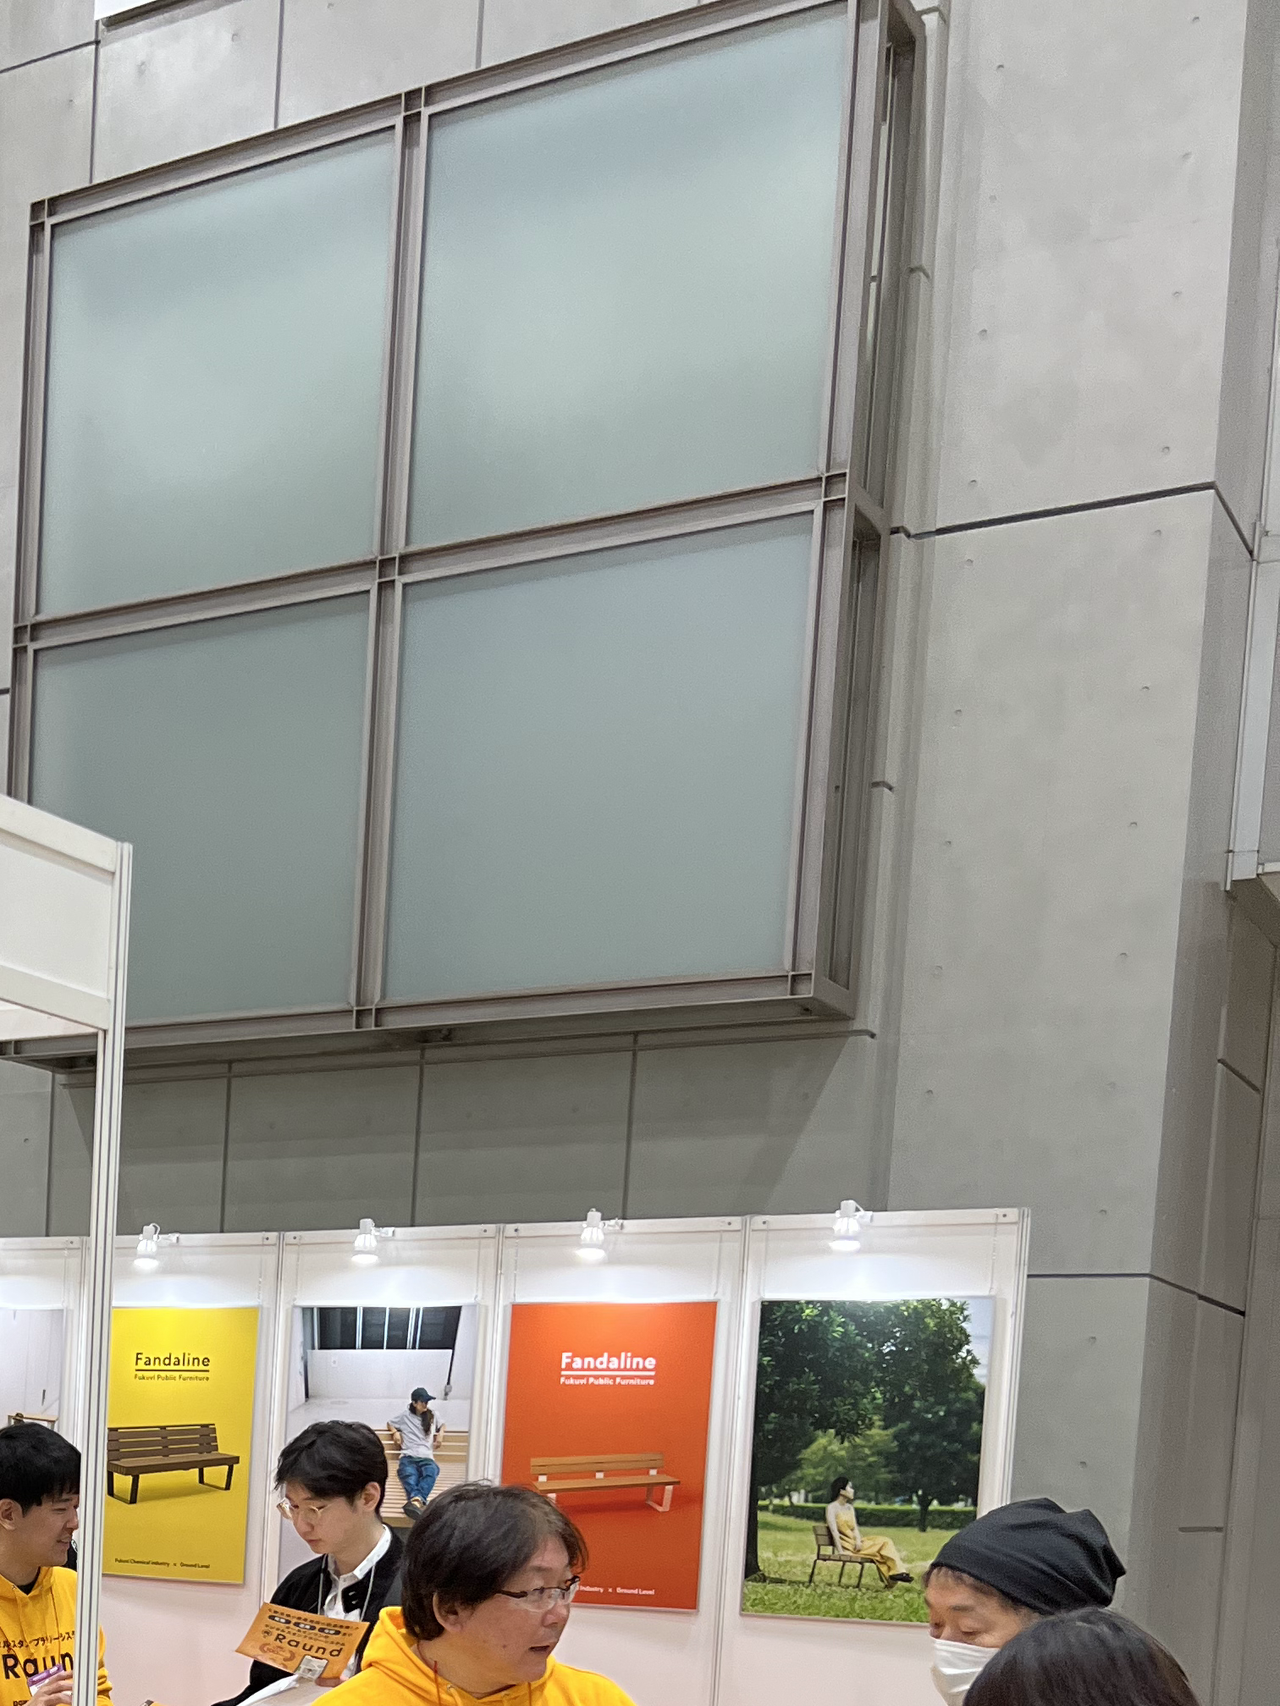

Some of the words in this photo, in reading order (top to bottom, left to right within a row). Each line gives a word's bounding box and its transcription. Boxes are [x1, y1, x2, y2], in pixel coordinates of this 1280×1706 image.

[135, 1352, 210, 1367] Fandaline
[561, 1352, 656, 1369] Fandaline
[588, 1377, 613, 1385] Public
[615, 1377, 655, 1386] Furniture
[274, 1633, 343, 1657] Raund
[2, 1652, 74, 1679] Raun
